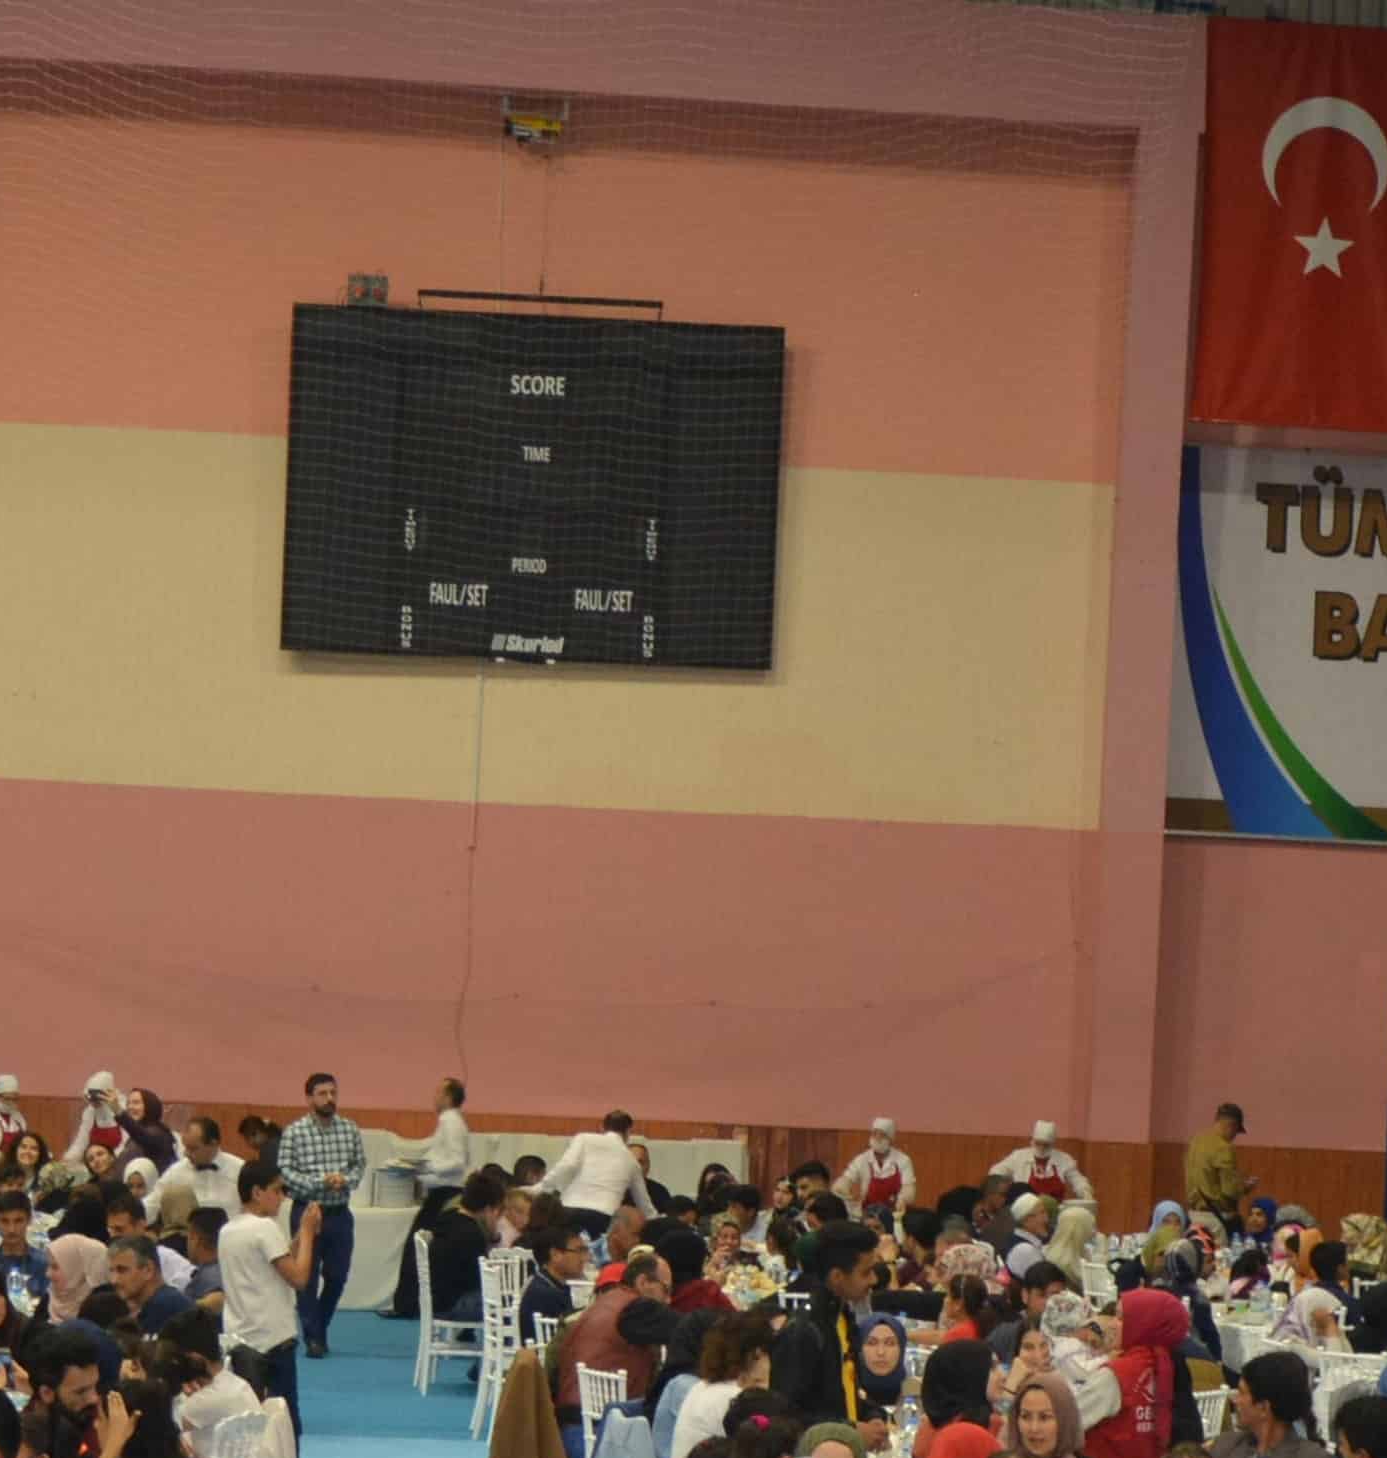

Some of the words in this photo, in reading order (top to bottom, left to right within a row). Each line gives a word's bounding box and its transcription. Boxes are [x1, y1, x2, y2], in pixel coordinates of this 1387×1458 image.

[511, 375, 566, 396] SCORE
[522, 446, 551, 463] TIME
[429, 581, 489, 607] FAUL/SET
[574, 588, 634, 612] FAUL/SET
